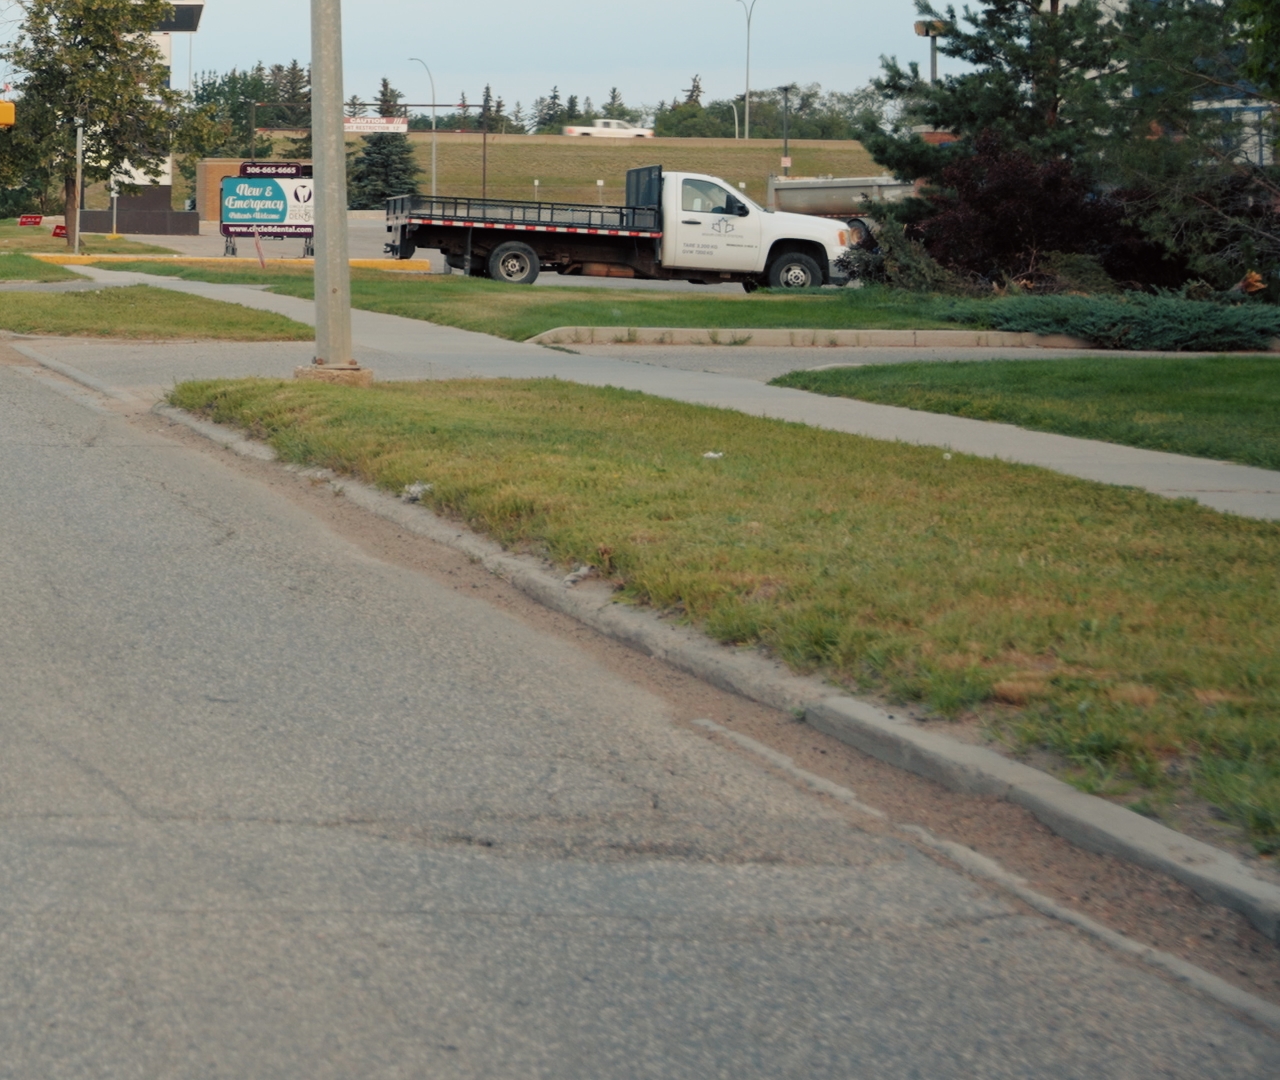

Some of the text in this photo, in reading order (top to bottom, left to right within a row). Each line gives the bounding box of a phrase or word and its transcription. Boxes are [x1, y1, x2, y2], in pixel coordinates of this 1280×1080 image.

[236, 183, 273, 197] New &
[224, 195, 284, 212] Emergency
[228, 211, 252, 219] Patients
[252, 211, 280, 219] Welcome
